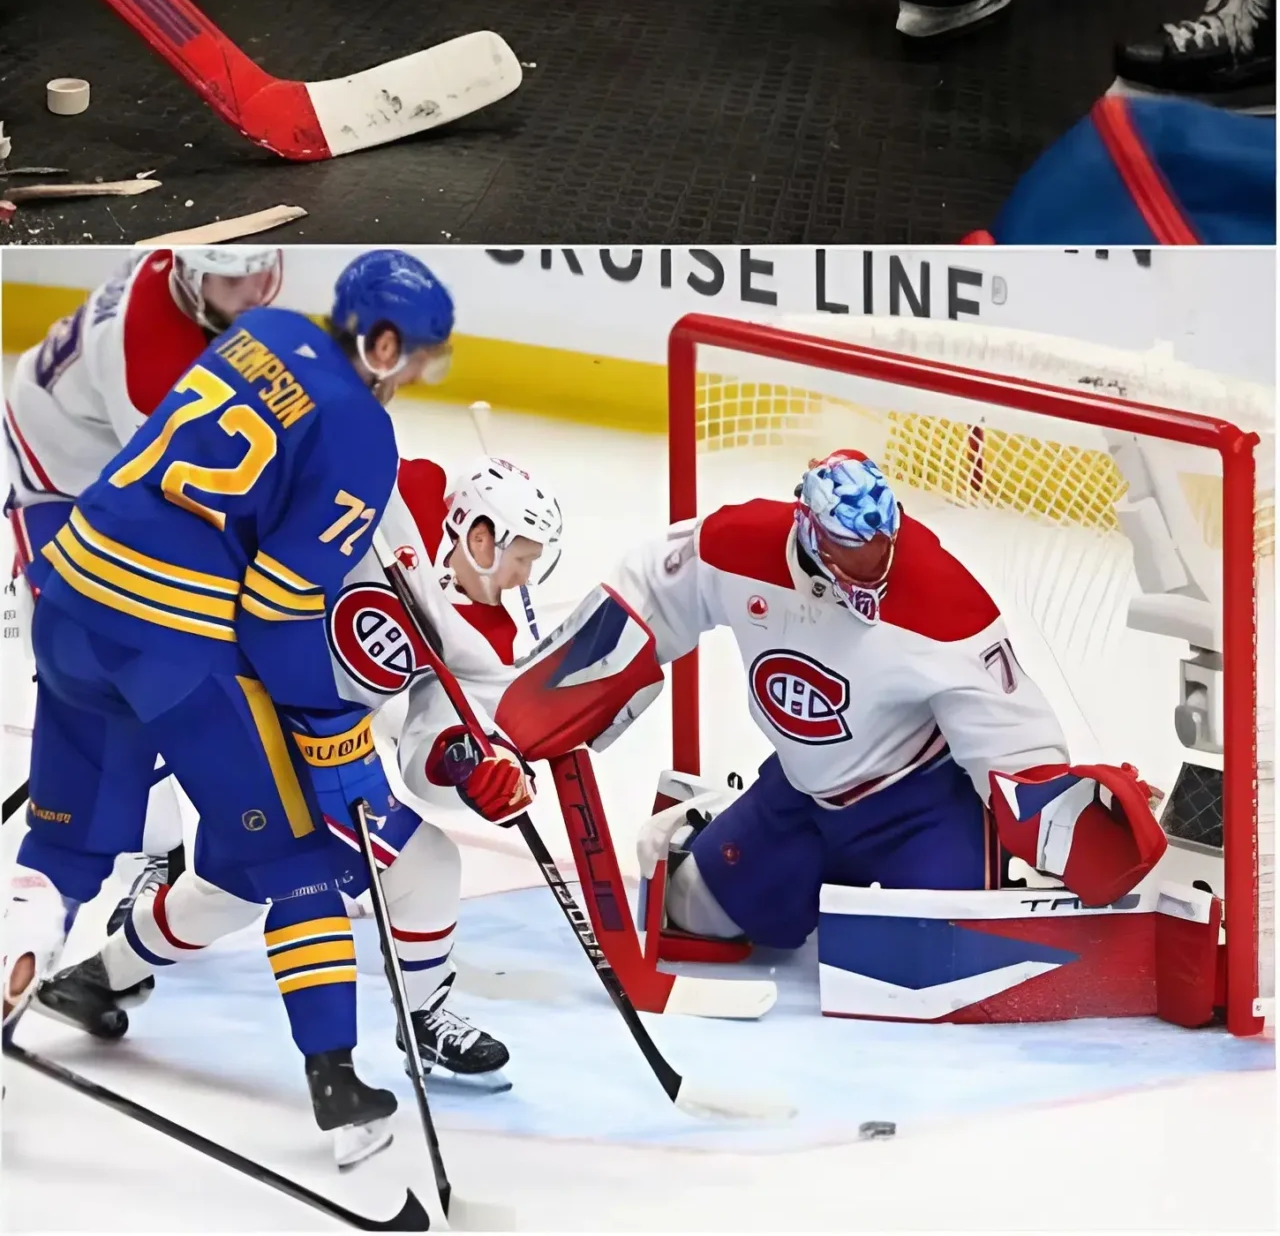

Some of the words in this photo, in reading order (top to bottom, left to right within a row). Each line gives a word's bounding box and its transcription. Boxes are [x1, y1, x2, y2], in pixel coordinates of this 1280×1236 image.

[215, 328, 317, 430] THOMPSON
[107, 363, 278, 533] 72
[317, 489, 377, 557] 72
